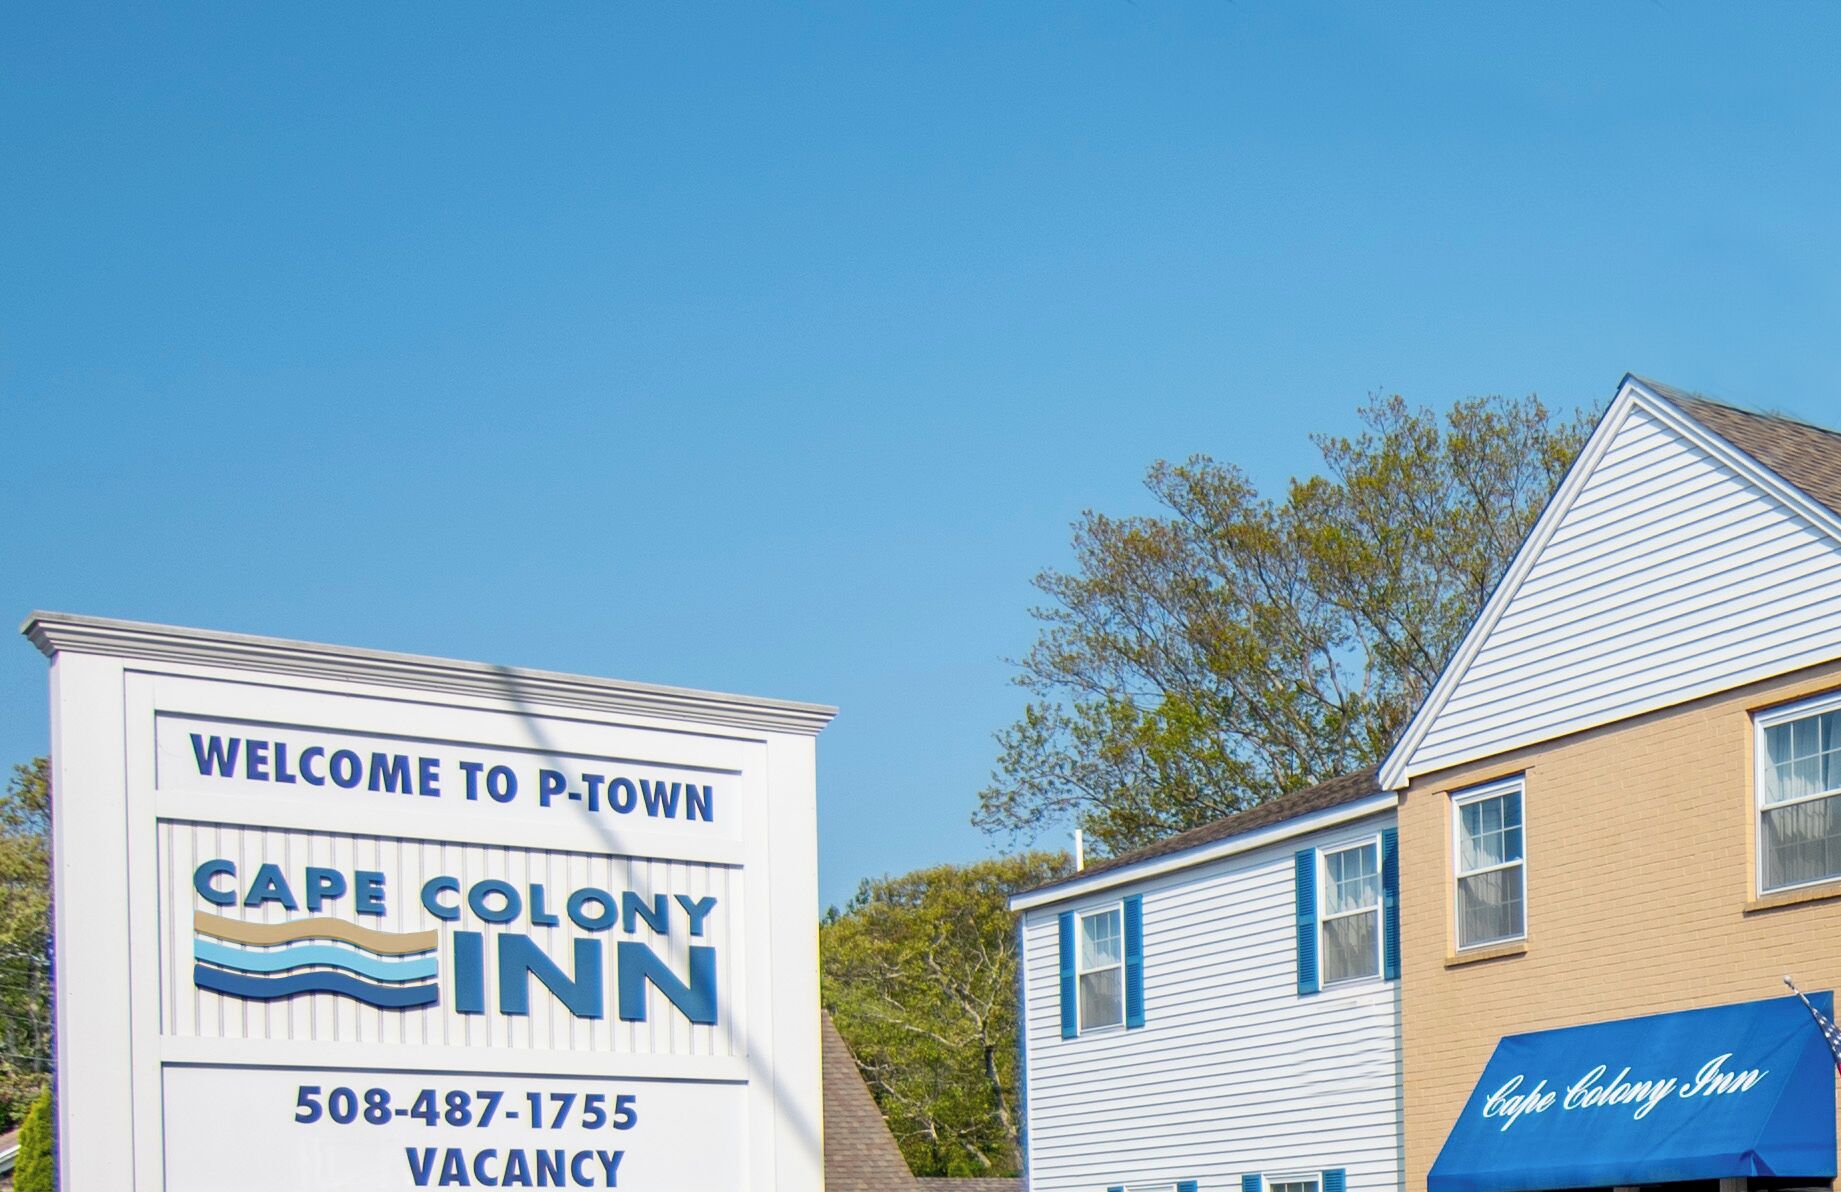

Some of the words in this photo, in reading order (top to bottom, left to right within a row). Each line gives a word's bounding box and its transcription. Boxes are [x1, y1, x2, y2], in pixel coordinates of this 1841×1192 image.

[189, 733, 441, 797] WELCOME
[459, 761, 518, 803] TO
[539, 768, 714, 822] P-TOWN
[193, 859, 387, 917] CAPE
[420, 875, 718, 937] COLONY
[453, 930, 718, 1026] INN
[294, 1085, 638, 1130] 508-487-1755
[1482, 1074, 1556, 1132] Cape
[1563, 1064, 1678, 1121] Colony
[1679, 1052, 1769, 1099] Inn
[405, 1147, 626, 1188] VACANCY
